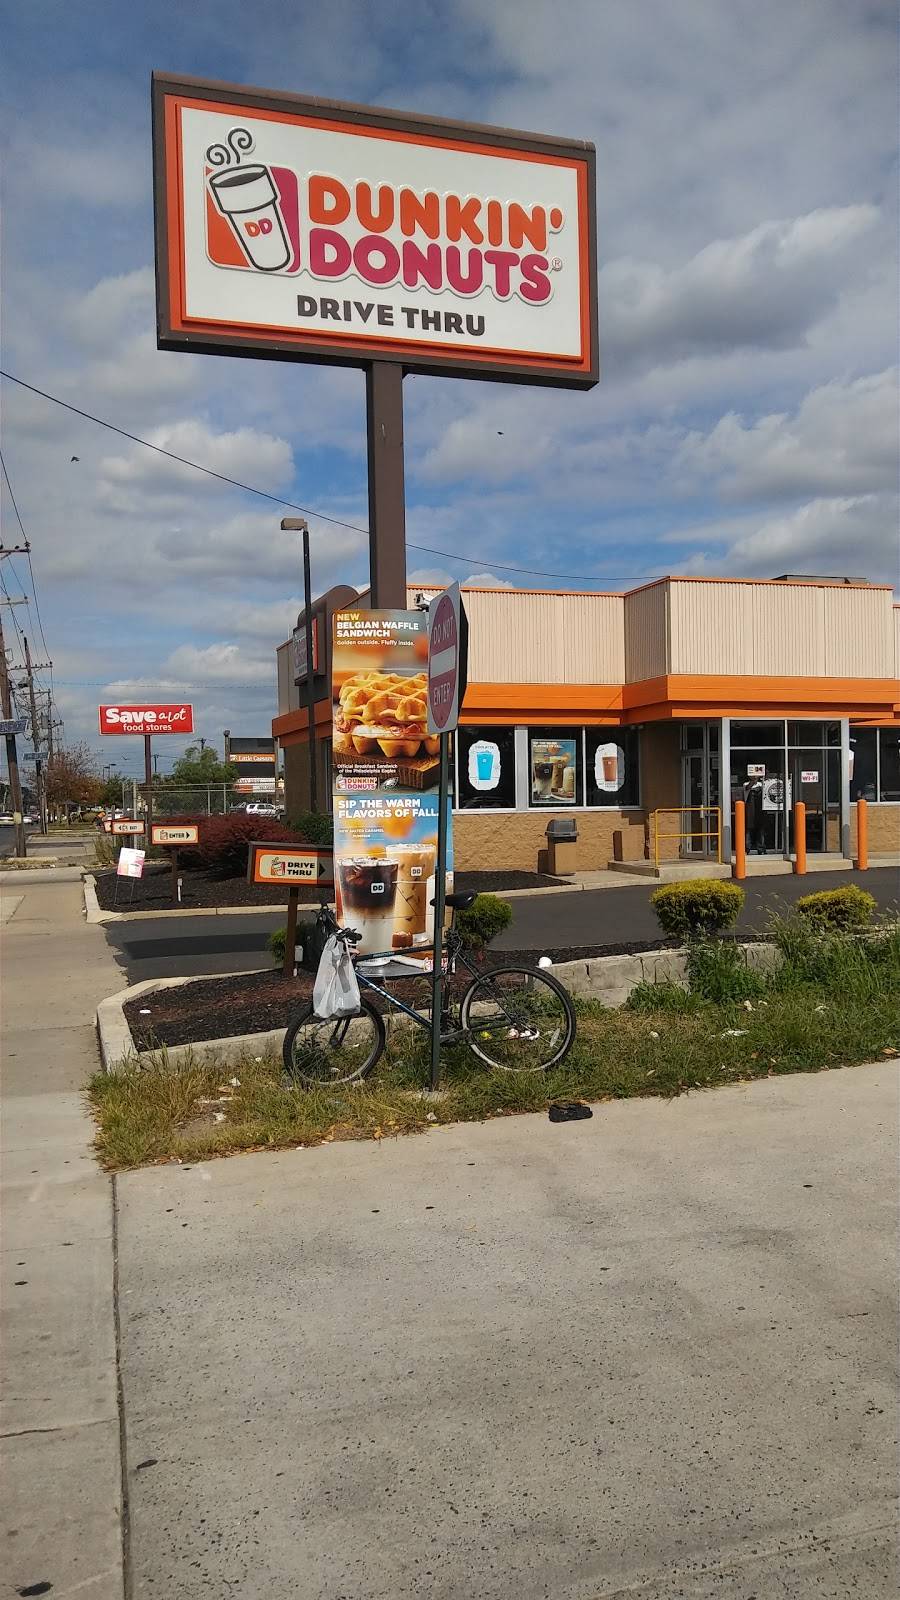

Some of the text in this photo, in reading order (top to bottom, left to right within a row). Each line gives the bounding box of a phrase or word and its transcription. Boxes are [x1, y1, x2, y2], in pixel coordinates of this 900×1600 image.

[308, 174, 562, 252] DUNKIN'
[244, 218, 273, 237] DD
[309, 228, 551, 302] DONUTS
[297, 295, 485, 336] DRIVE THRU
[336, 613, 360, 621] NEW
[336, 621, 419, 630] BELGIAN WAFFLE
[433, 616, 453, 645] DO NOT
[433, 682, 450, 706] ENTER
[105, 708, 157, 724] Save
[123, 723, 172, 731] food stores
[338, 799, 420, 808] SIP THE WARM
[338, 809, 392, 818] FLAVORS
[395, 809, 410, 817] OF
